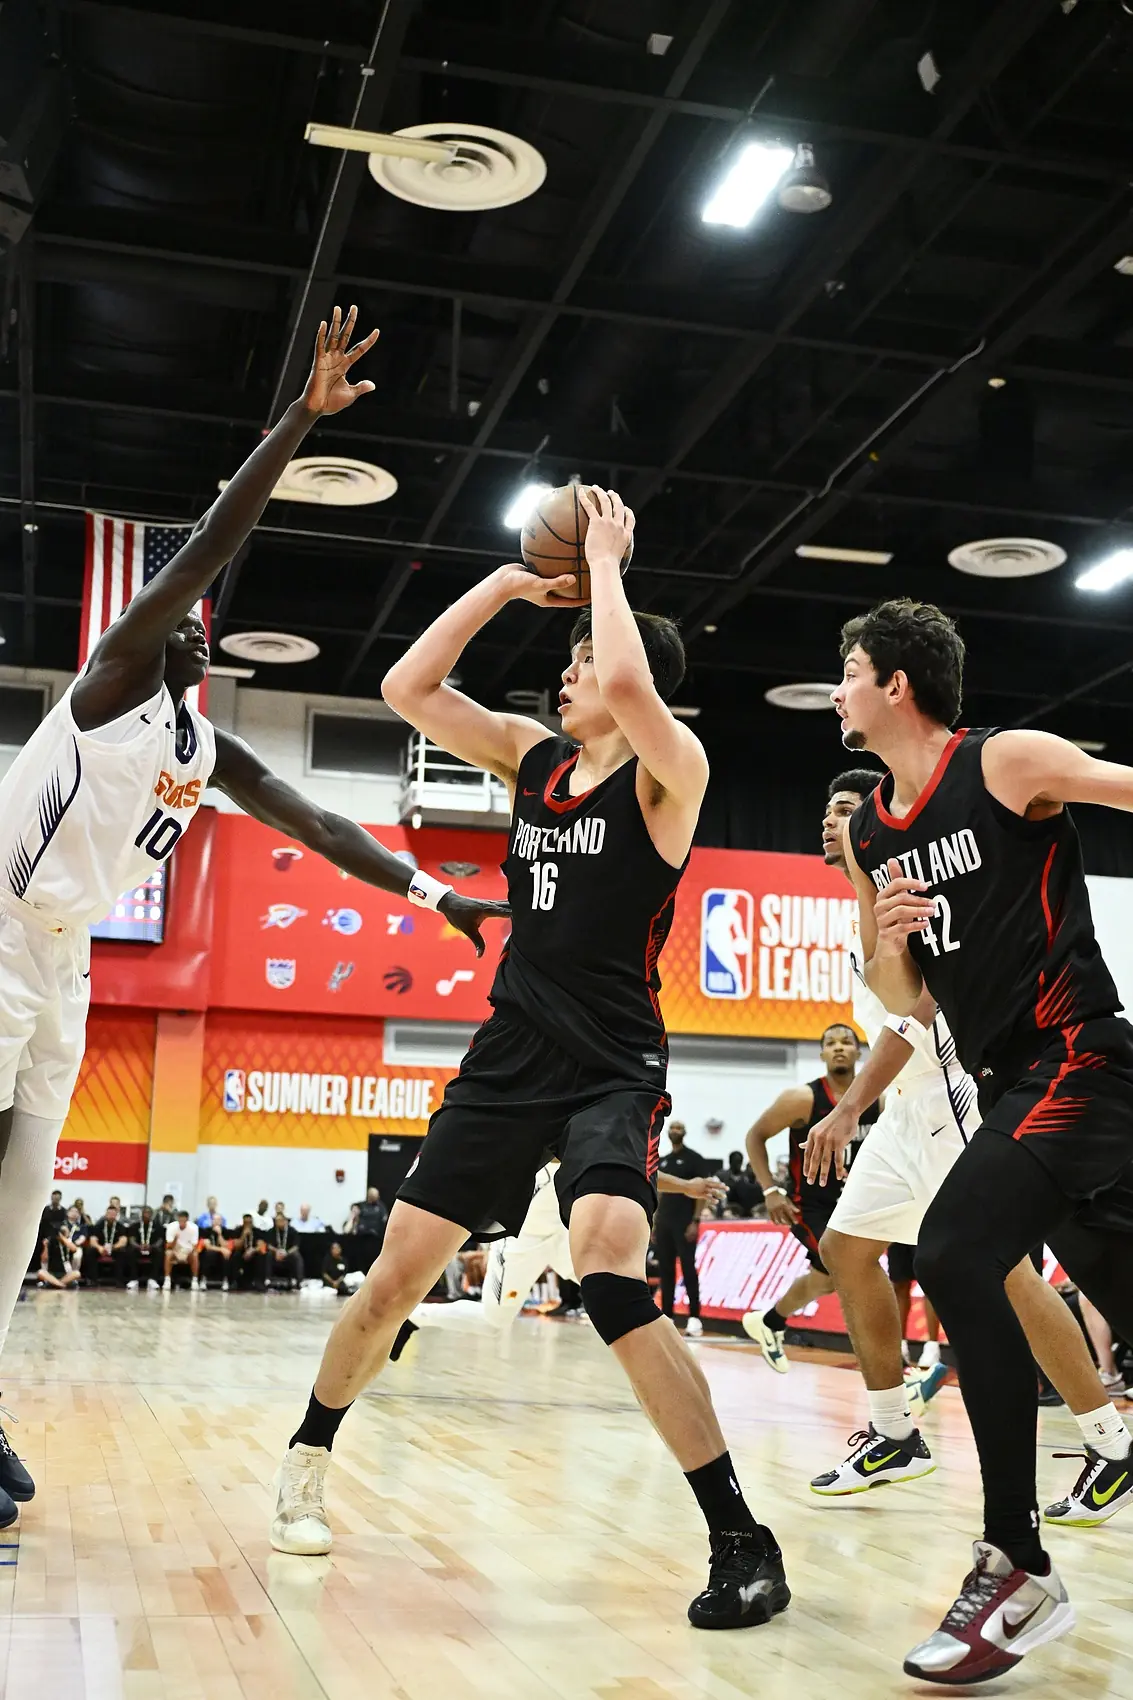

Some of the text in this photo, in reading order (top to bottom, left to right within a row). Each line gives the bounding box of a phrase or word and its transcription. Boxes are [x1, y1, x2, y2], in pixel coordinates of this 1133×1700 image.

[134, 807, 182, 860] 10
[870, 828, 982, 894] POTLAND
[529, 861, 559, 911] 16
[759, 892, 859, 950] SUMM
[918, 894, 961, 957] 42
[758, 945, 854, 1004] LEAGU
[246, 1070, 435, 1120] SUMMER LEAGUE
[53, 1151, 89, 1175] ogle
